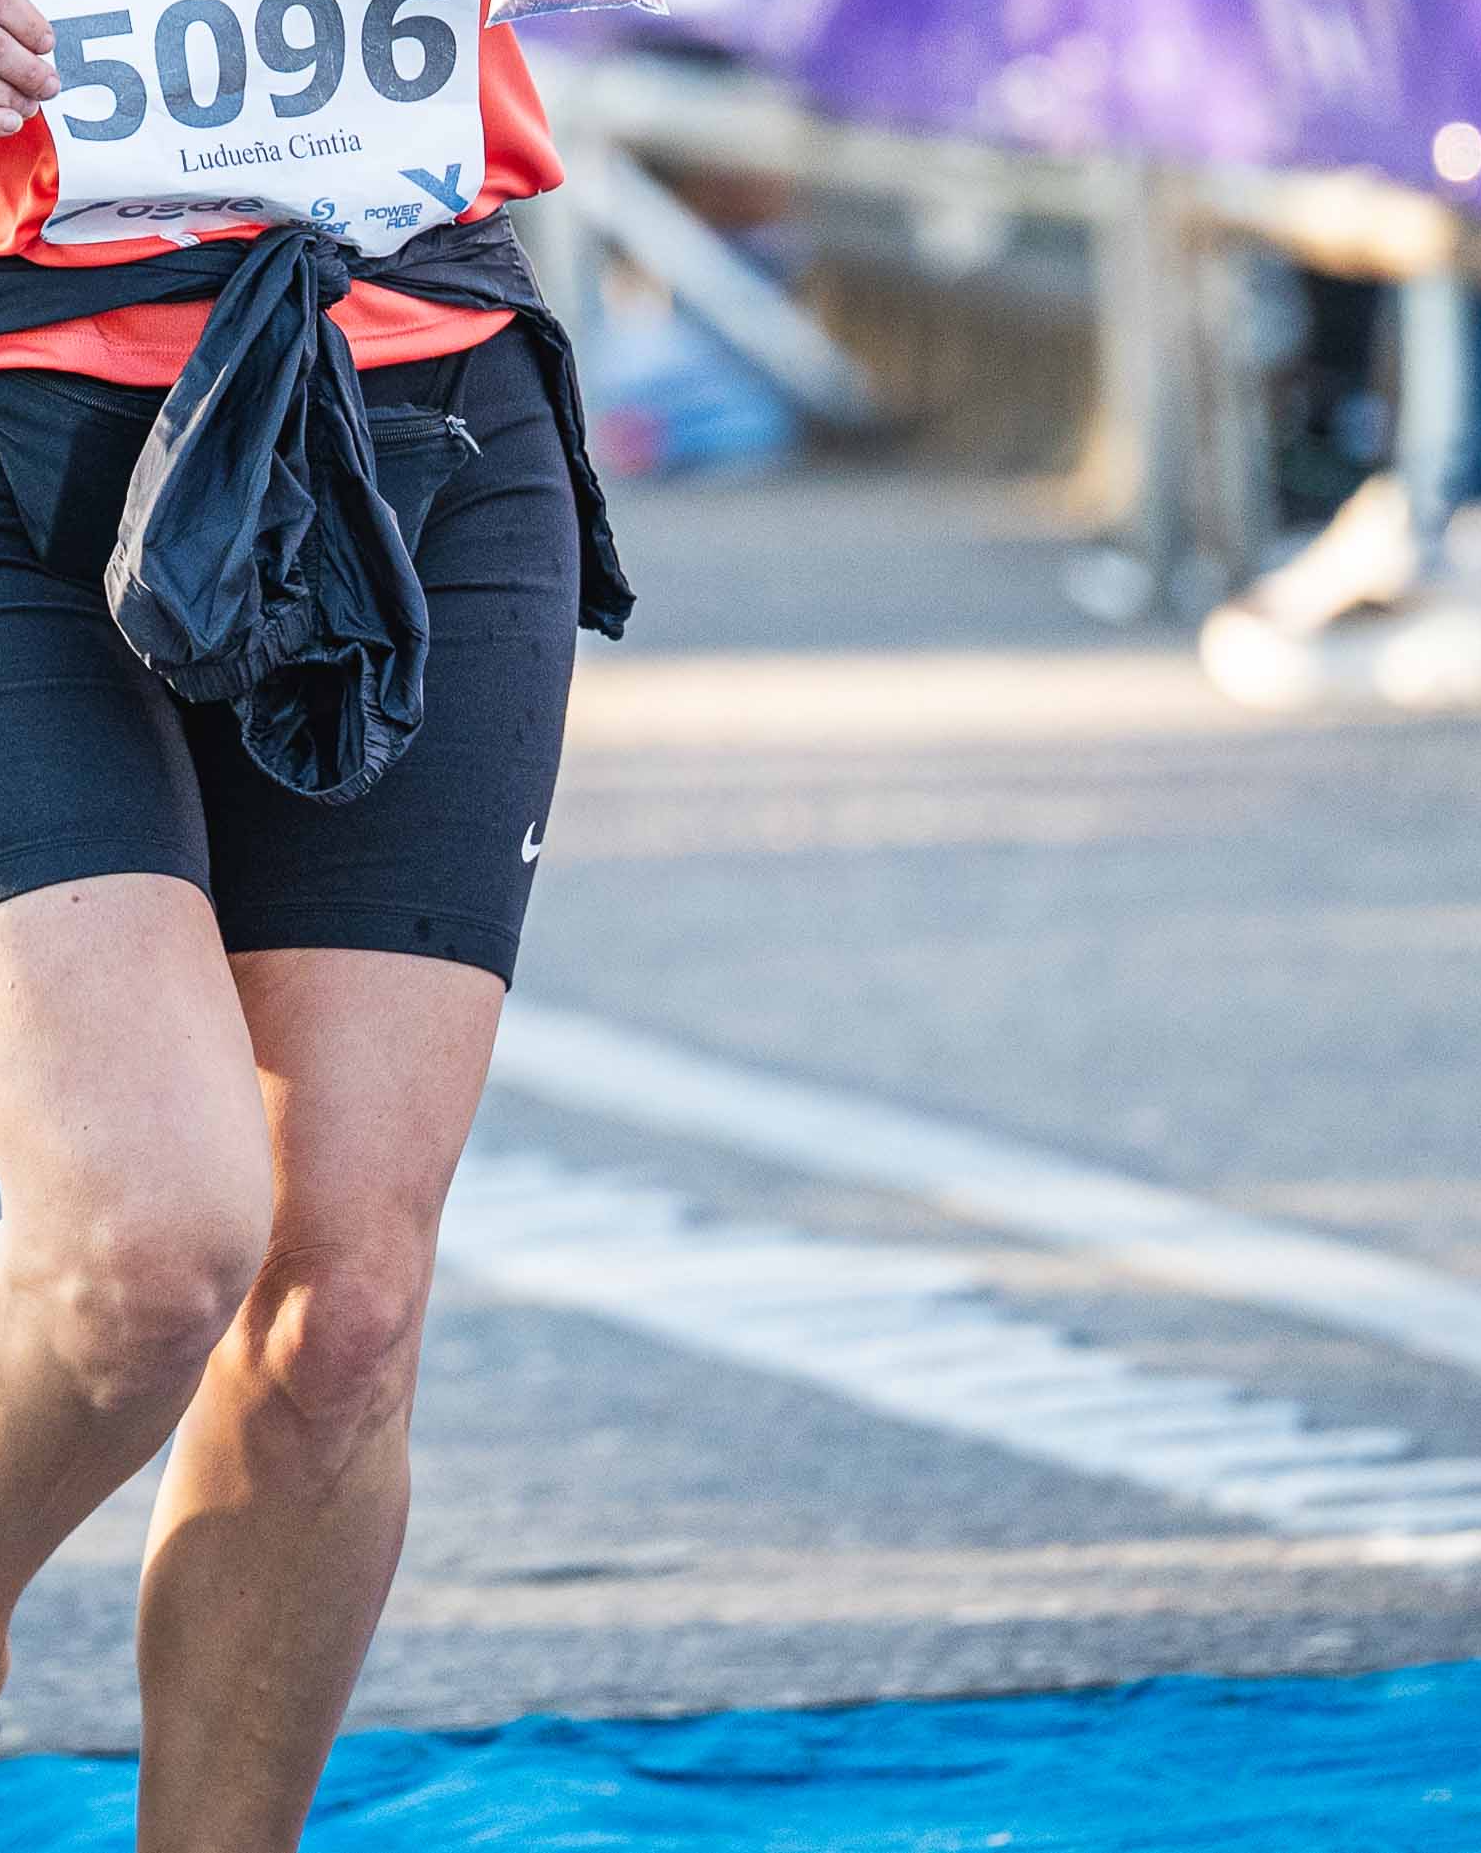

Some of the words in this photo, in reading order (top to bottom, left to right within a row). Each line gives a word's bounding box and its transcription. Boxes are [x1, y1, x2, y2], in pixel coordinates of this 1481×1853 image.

[179, 137, 283, 173] Ludueña
[288, 128, 364, 159] Cintia
[117, 198, 264, 221] osde
[364, 202, 423, 222] POWER
